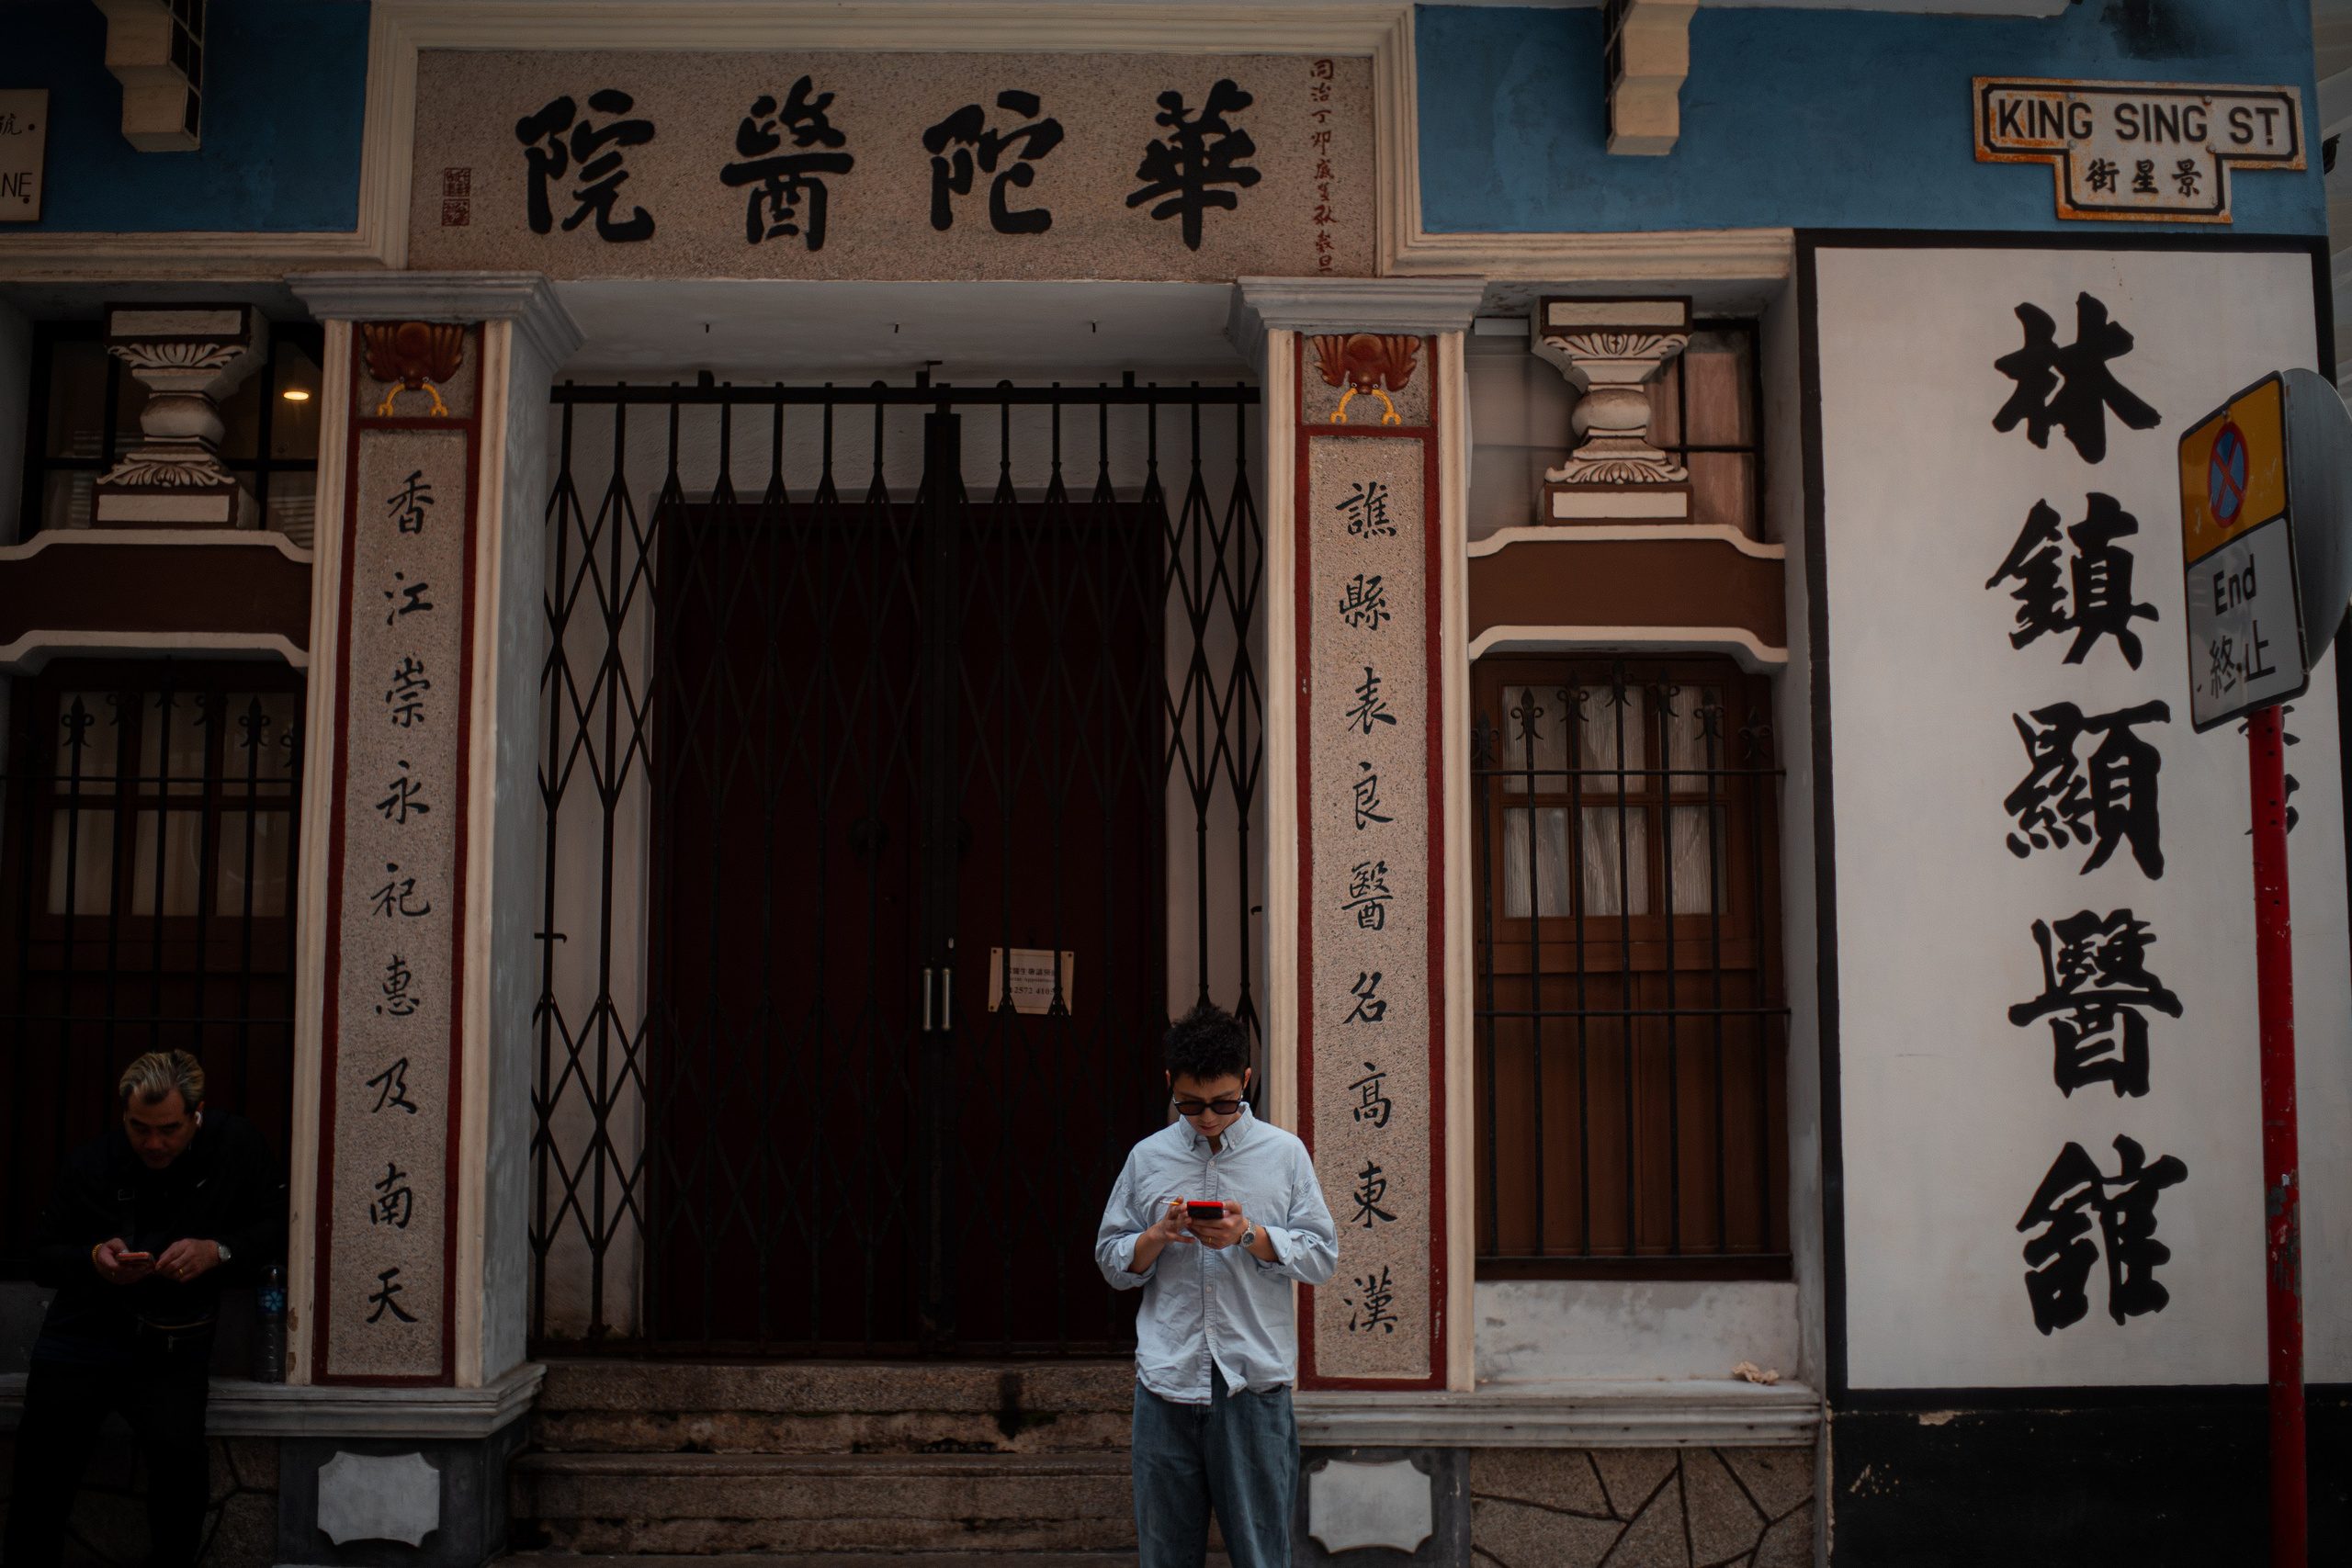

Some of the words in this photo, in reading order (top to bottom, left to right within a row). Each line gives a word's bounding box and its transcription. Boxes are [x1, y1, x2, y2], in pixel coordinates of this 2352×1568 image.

[1998, 98, 2094, 140] KING
[2114, 103, 2208, 143] SING
[514, 74, 1262, 253] 華陀醫院
[2213, 553, 2256, 616] End
[2209, 619, 2277, 700] 終止
[367, 469, 435, 1325] 香江崇永祀惠及南天
